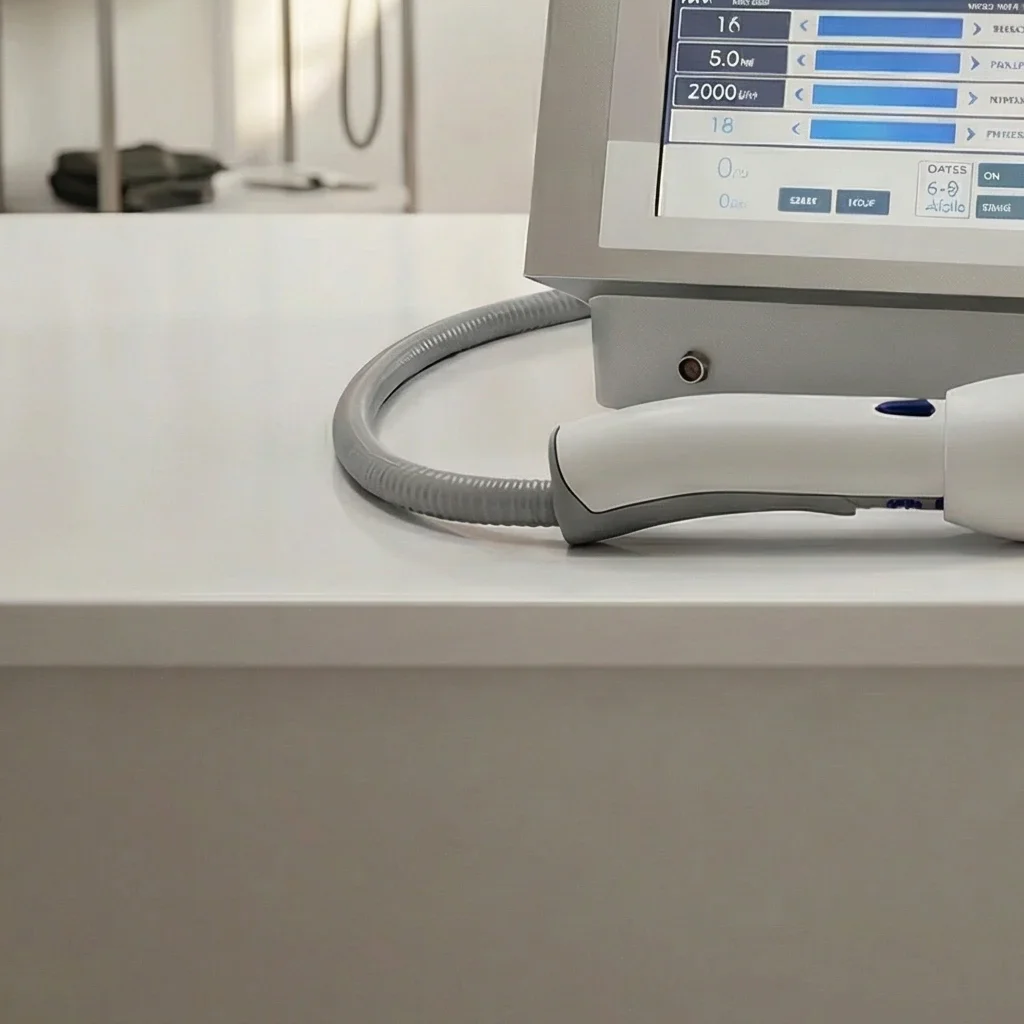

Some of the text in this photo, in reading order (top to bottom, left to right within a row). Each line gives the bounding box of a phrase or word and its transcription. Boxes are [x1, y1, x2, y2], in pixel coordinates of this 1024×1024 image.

[718, 16, 740, 33] 16
[688, 83, 737, 101] 2000
[712, 116, 733, 134] 18
[983, 171, 1000, 181] ON
